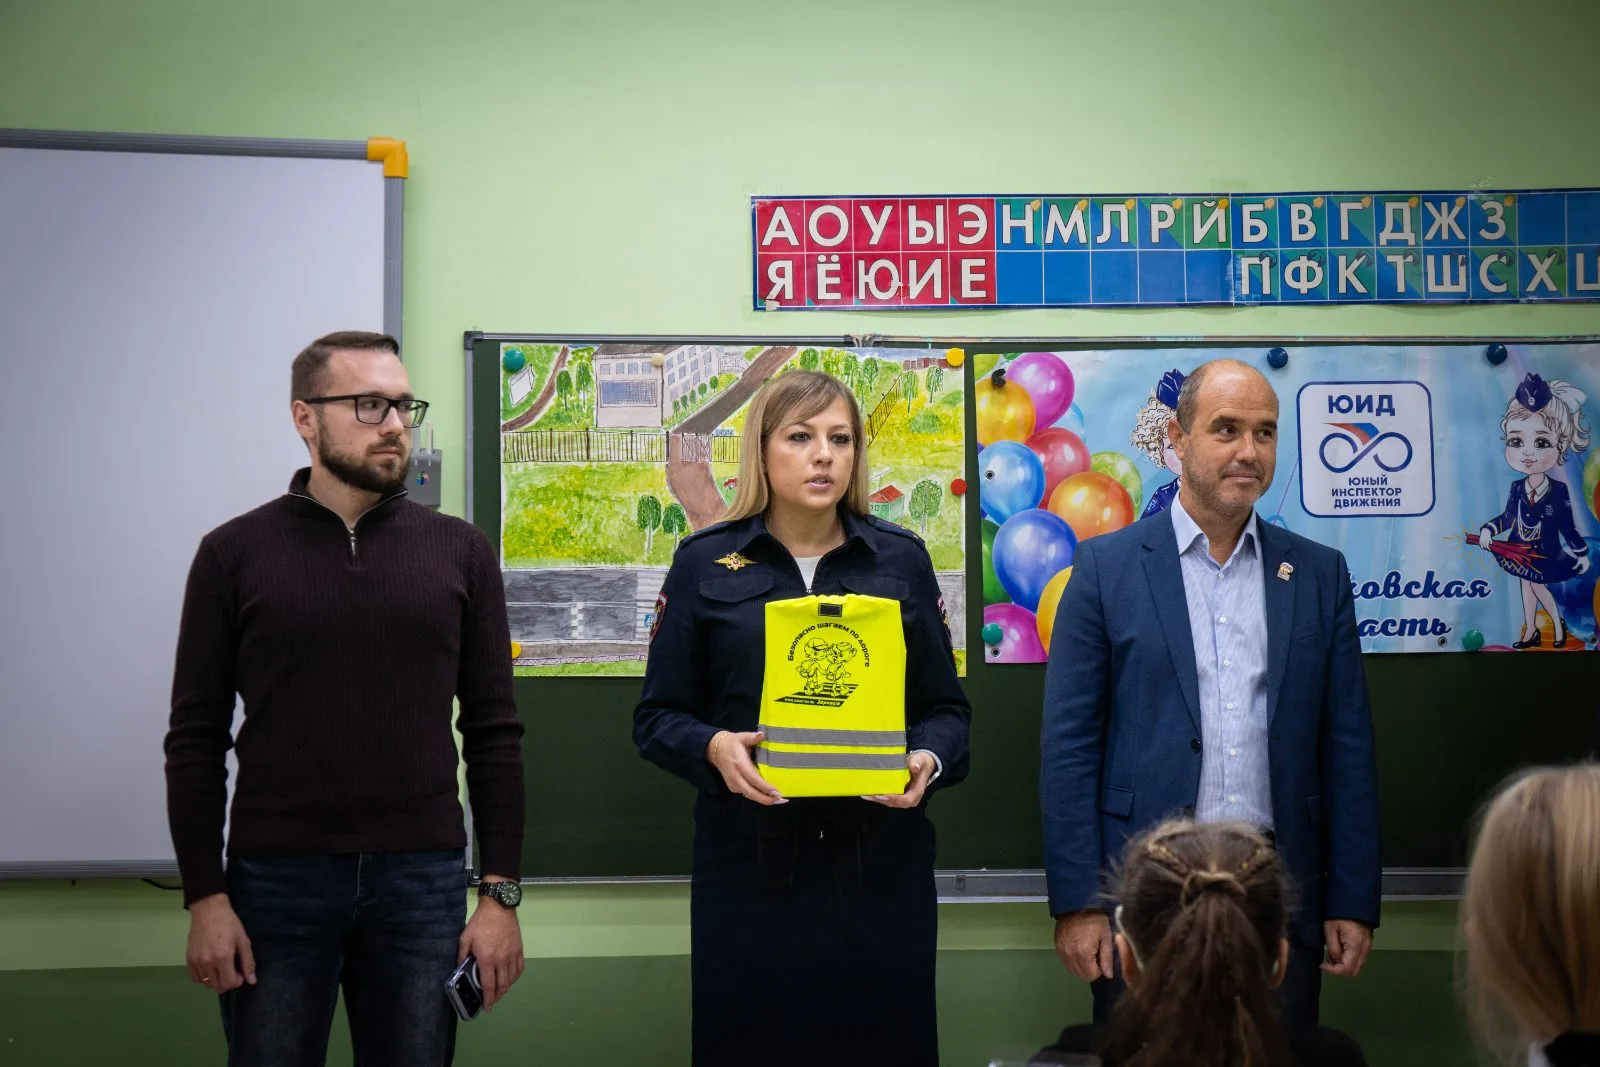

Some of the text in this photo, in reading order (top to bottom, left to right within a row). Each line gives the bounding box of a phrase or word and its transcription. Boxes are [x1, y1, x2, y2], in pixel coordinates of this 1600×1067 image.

[761, 200, 1506, 247] А О У Ы Э Н М Л Р Й Б В Г Д Ж З
[766, 260, 794, 301] Я
[816, 254, 842, 300] Ё
[858, 258, 901, 300] Ю
[907, 258, 943, 299] И
[960, 258, 987, 298] Е
[1239, 257, 1271, 295] П
[1284, 254, 1324, 294] Ф
[1338, 254, 1369, 294] К
[1386, 254, 1417, 293] Т
[1426, 253, 1467, 293] Ш
[1479, 253, 1508, 293] С
[1525, 253, 1558, 292] Х
[1327, 394, 1396, 417] ЮИД
[1348, 474, 1388, 486] ЮНЫЙ
[1331, 487, 1402, 497] ИНСПЕКТОР
[1333, 498, 1401, 509] ДВИЖЕНИЯ
[1357, 617, 1451, 637] асть
[788, 622, 870, 667] Безопасно шагаем по дороге
